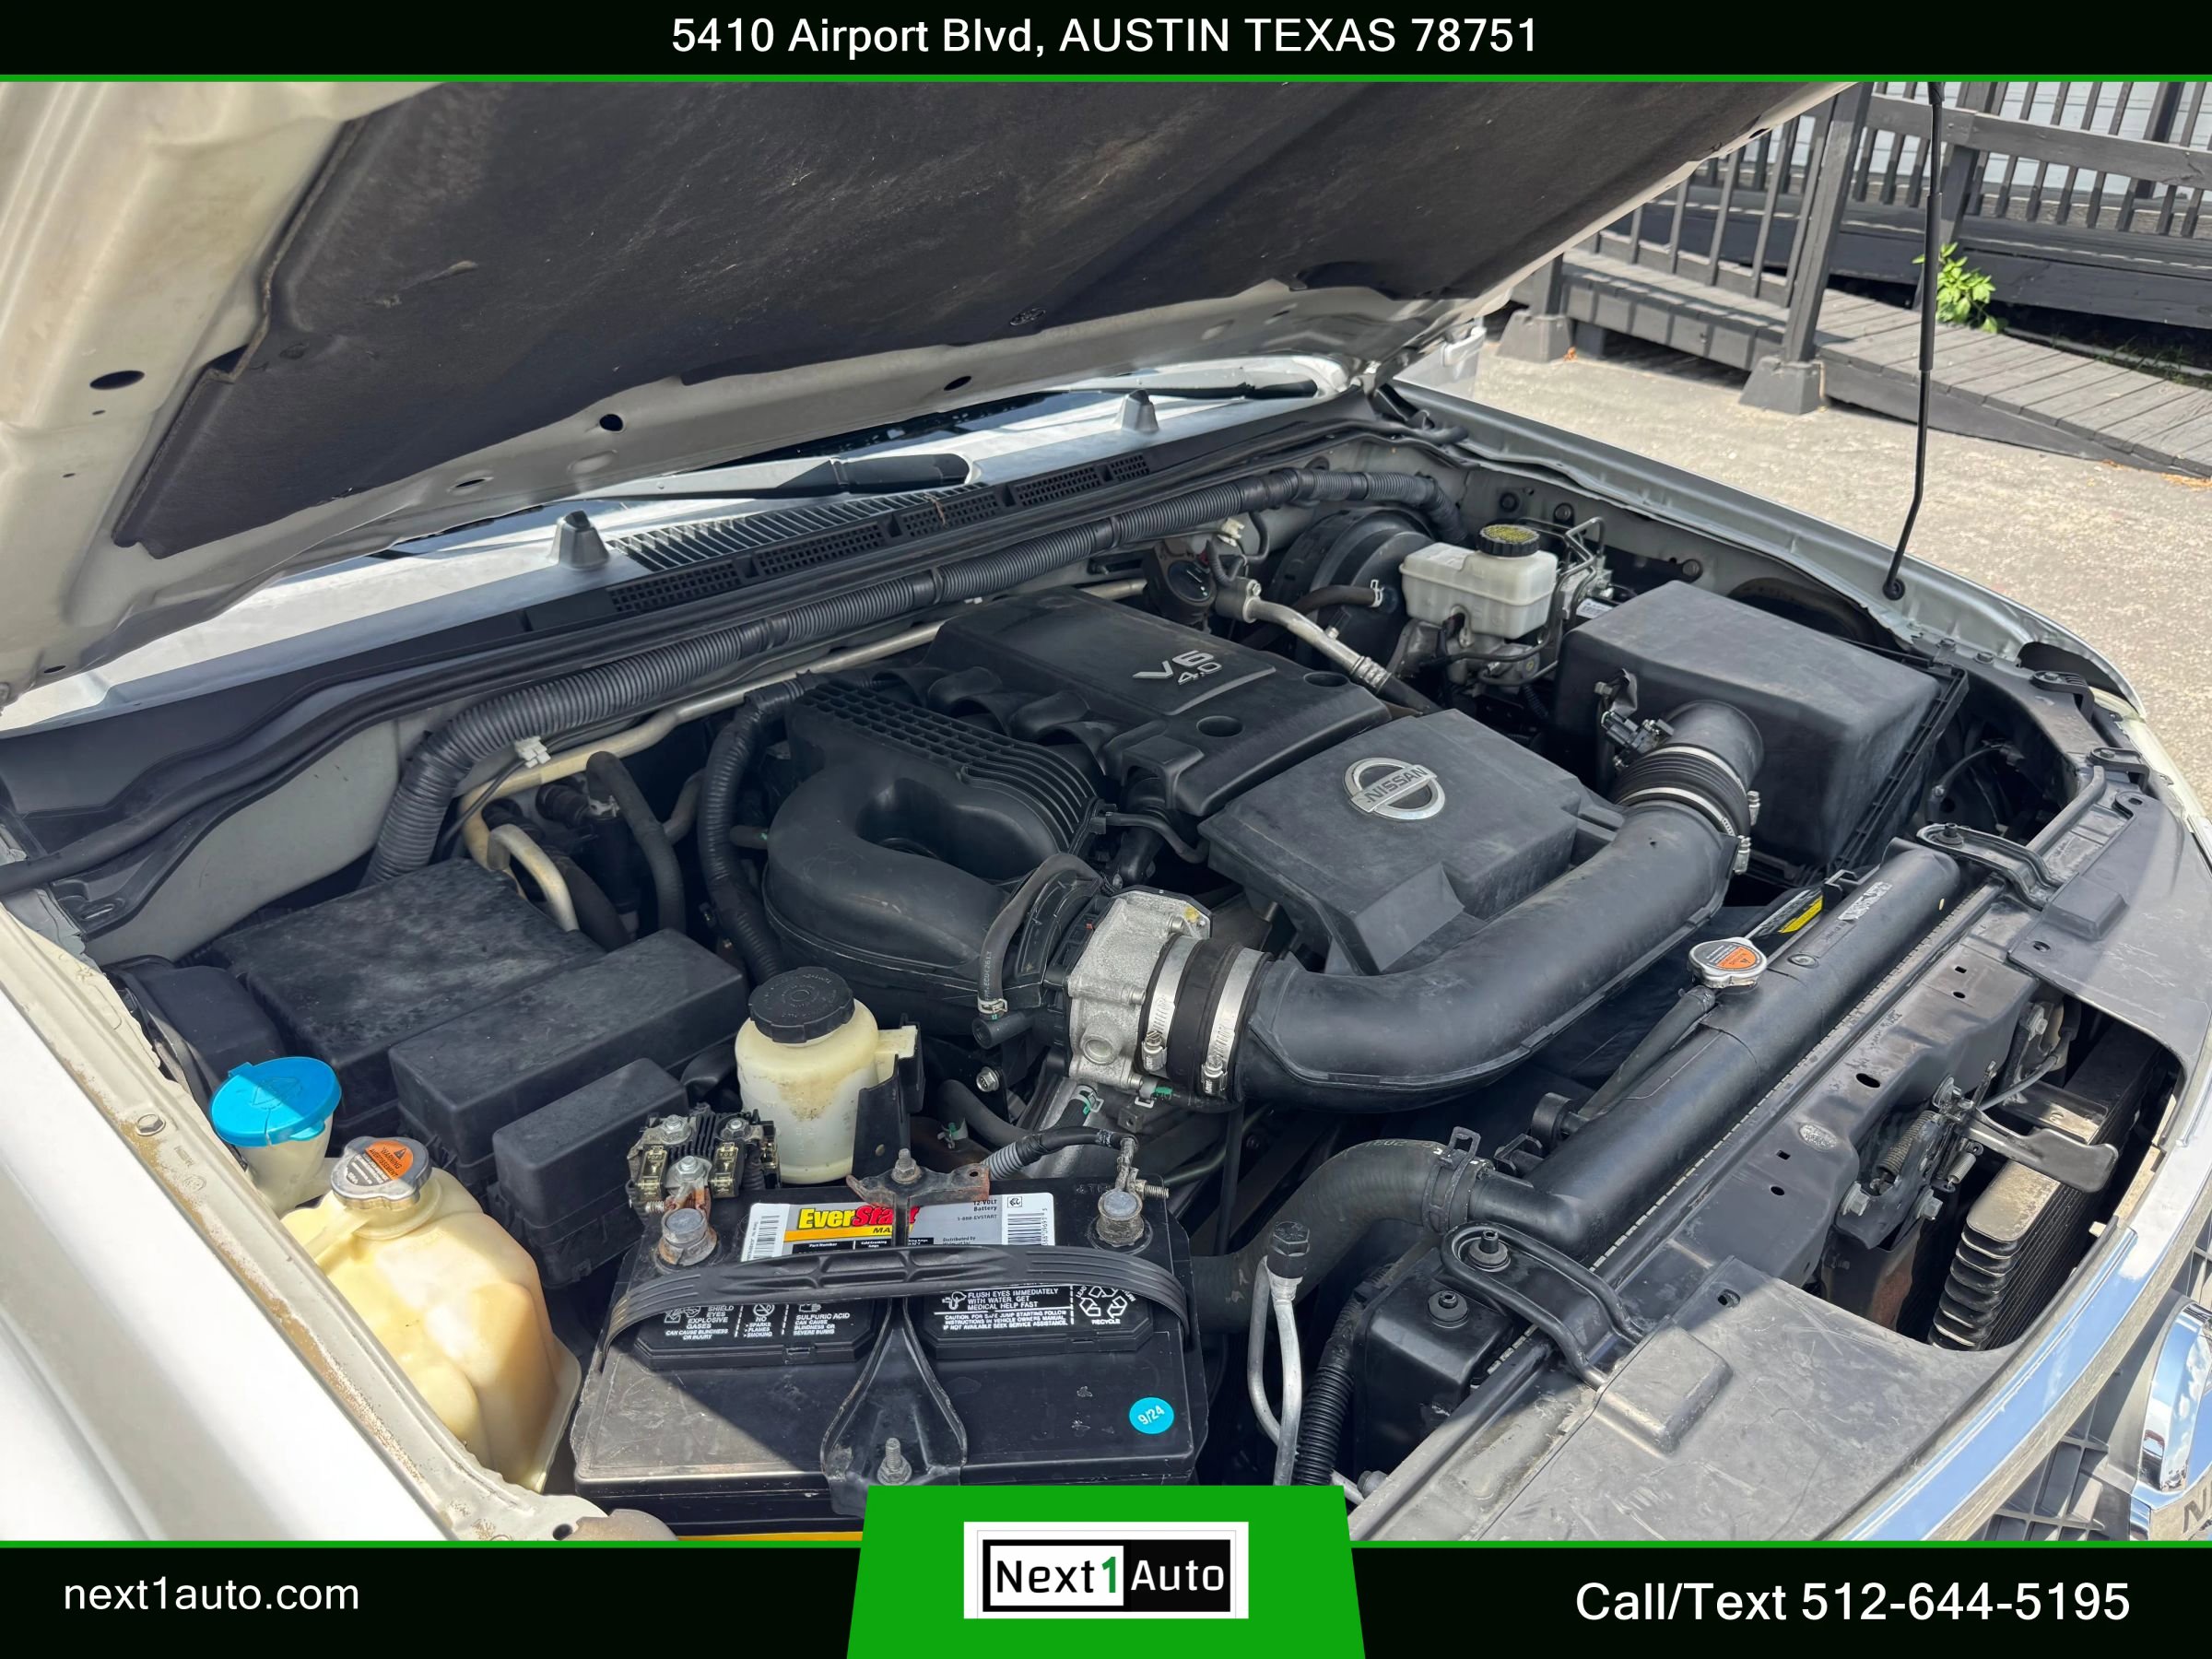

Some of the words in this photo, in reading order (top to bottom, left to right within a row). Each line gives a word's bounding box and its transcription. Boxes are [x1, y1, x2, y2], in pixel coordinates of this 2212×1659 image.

[1132, 649, 1216, 679] V6
[1177, 661, 1223, 686] 4.0
[1364, 767, 1429, 803] NISSAN
[381, 1147, 403, 1170] WARNING
[797, 1205, 921, 1230] EverStat
[1013, 1288, 1059, 1297] IMMEDIATELY
[1137, 1405, 1166, 1425] 9/24
